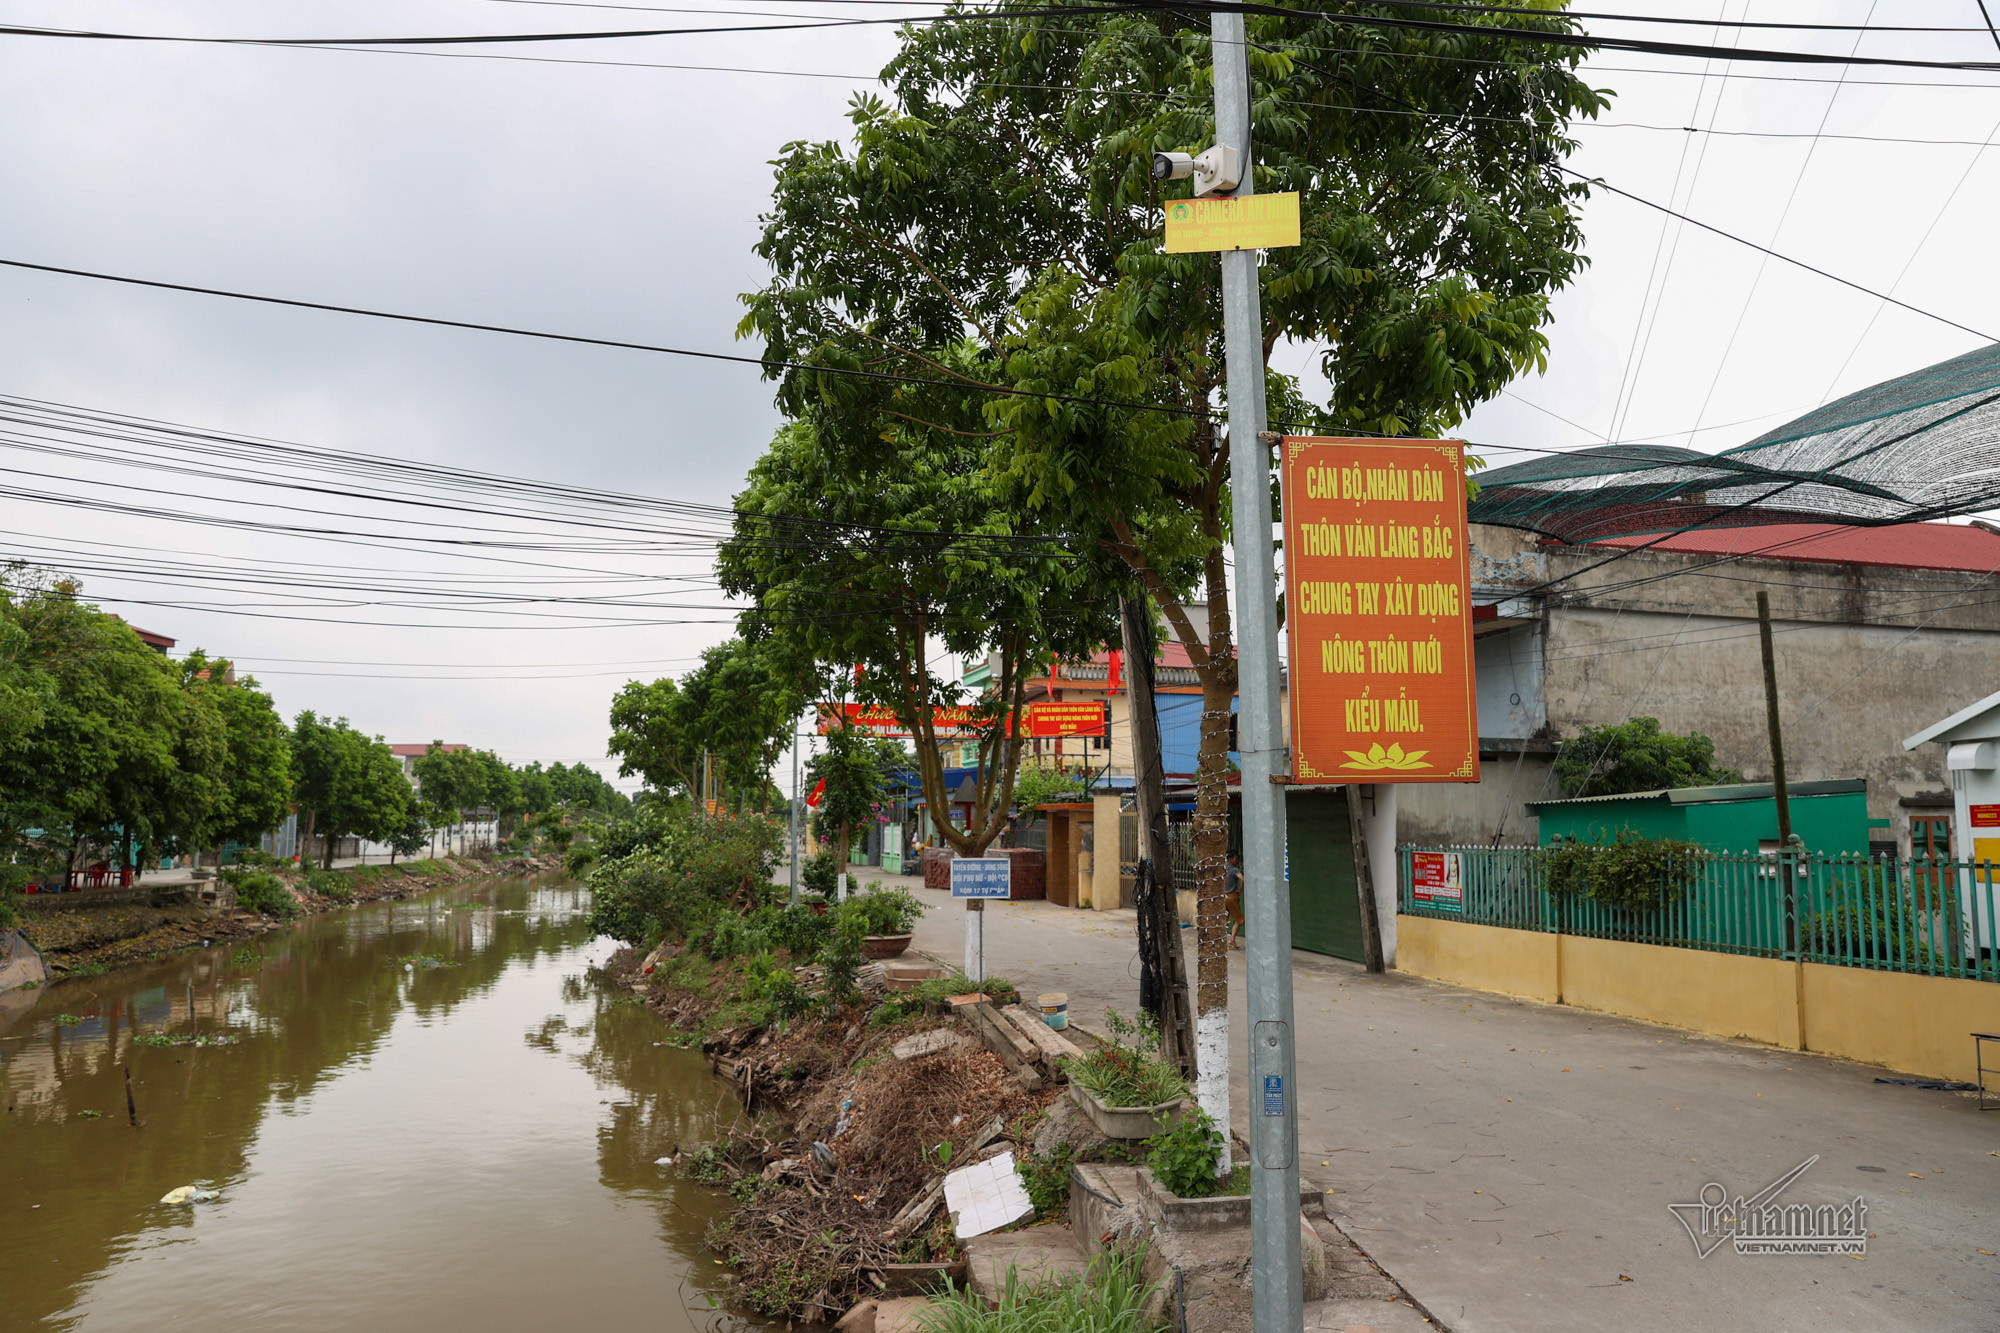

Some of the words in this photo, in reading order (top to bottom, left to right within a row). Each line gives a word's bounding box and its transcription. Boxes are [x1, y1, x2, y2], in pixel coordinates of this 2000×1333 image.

[1196, 200, 1244, 224] CAMERA
[1247, 198, 1264, 222] AN
[1267, 196, 1297, 220] NINH
[1306, 460, 1338, 500] CÁN
[1413, 464, 1444, 502] DÂN
[1301, 517, 1342, 557] THÔN
[1345, 518, 1376, 558] VĂN
[1380, 519, 1418, 559] LÃNG
[1423, 515, 1452, 560] BẮC
[1300, 581, 1352, 615] CHUNG
[1356, 583, 1380, 616] TAY
[1384, 576, 1413, 616] XÂY
[1418, 581, 1459, 624] DỰNG
[1322, 634, 1364, 674] NÔNG
[1368, 634, 1408, 674] THÔN
[1413, 634, 1442, 674] MỚI
[938, 708, 968, 721] NĂM
[1345, 686, 1380, 733] KIỂU
[1384, 687, 1424, 733] MẪU.
[963, 874, 974, 884] PHỤ
